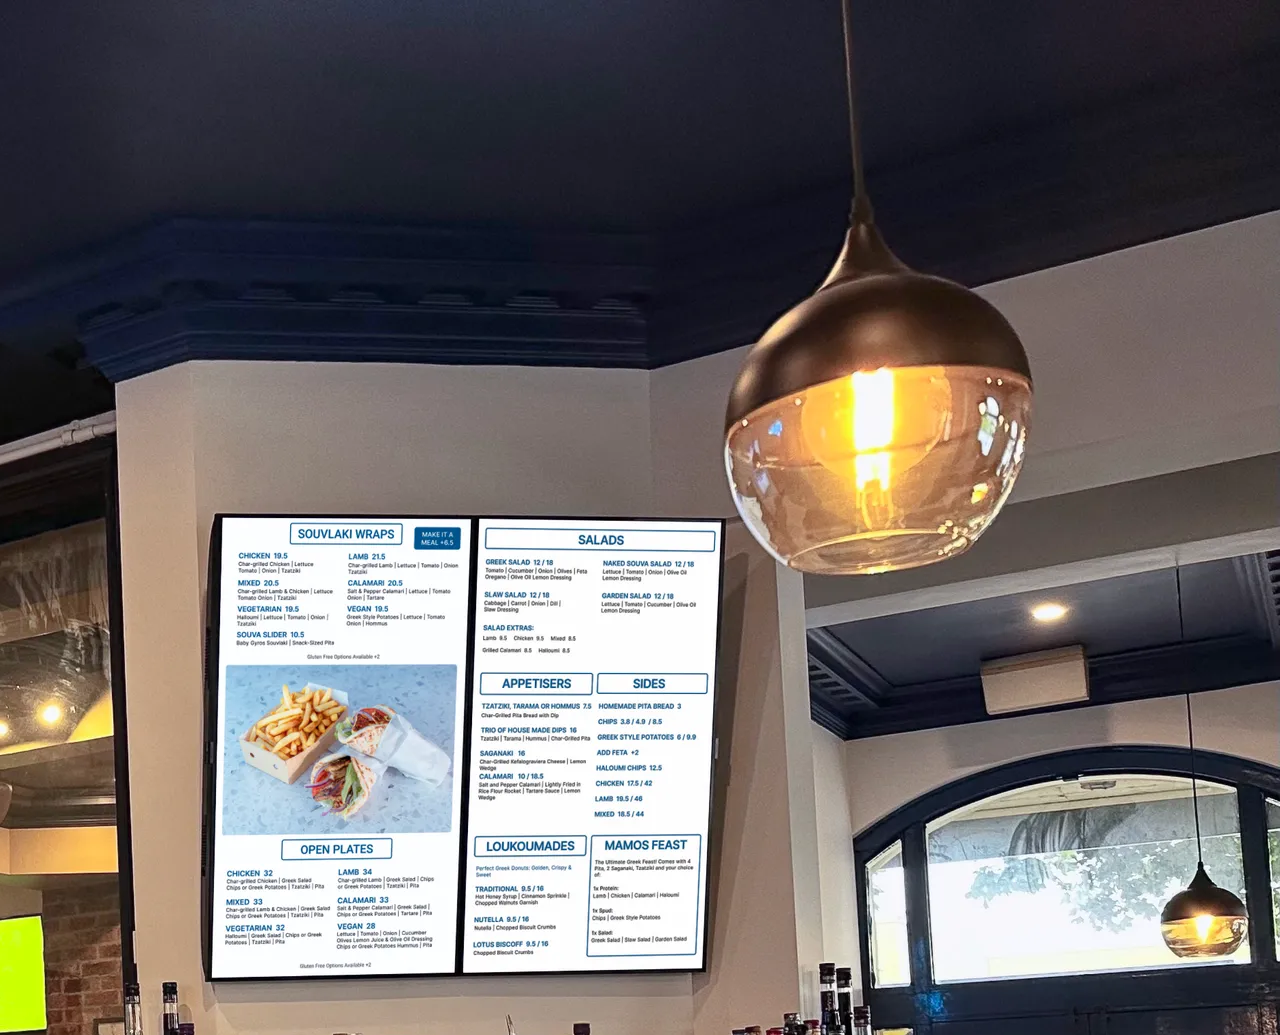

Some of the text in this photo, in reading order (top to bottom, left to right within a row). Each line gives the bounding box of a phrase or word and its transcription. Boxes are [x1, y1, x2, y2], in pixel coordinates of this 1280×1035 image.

[297, 528, 394, 539] SOUVLAKI WRAPS
[578, 534, 624, 545] SALADS
[501, 678, 571, 688] APPETISERS
[632, 678, 666, 688] SIDES
[300, 843, 373, 854] OPEN PLATES
[486, 840, 575, 851] LOUKOUMADES
[604, 839, 688, 850] MAMOS FEAST
[226, 869, 260, 877] CHICKEN
[225, 924, 272, 932] VEGETARIAN
